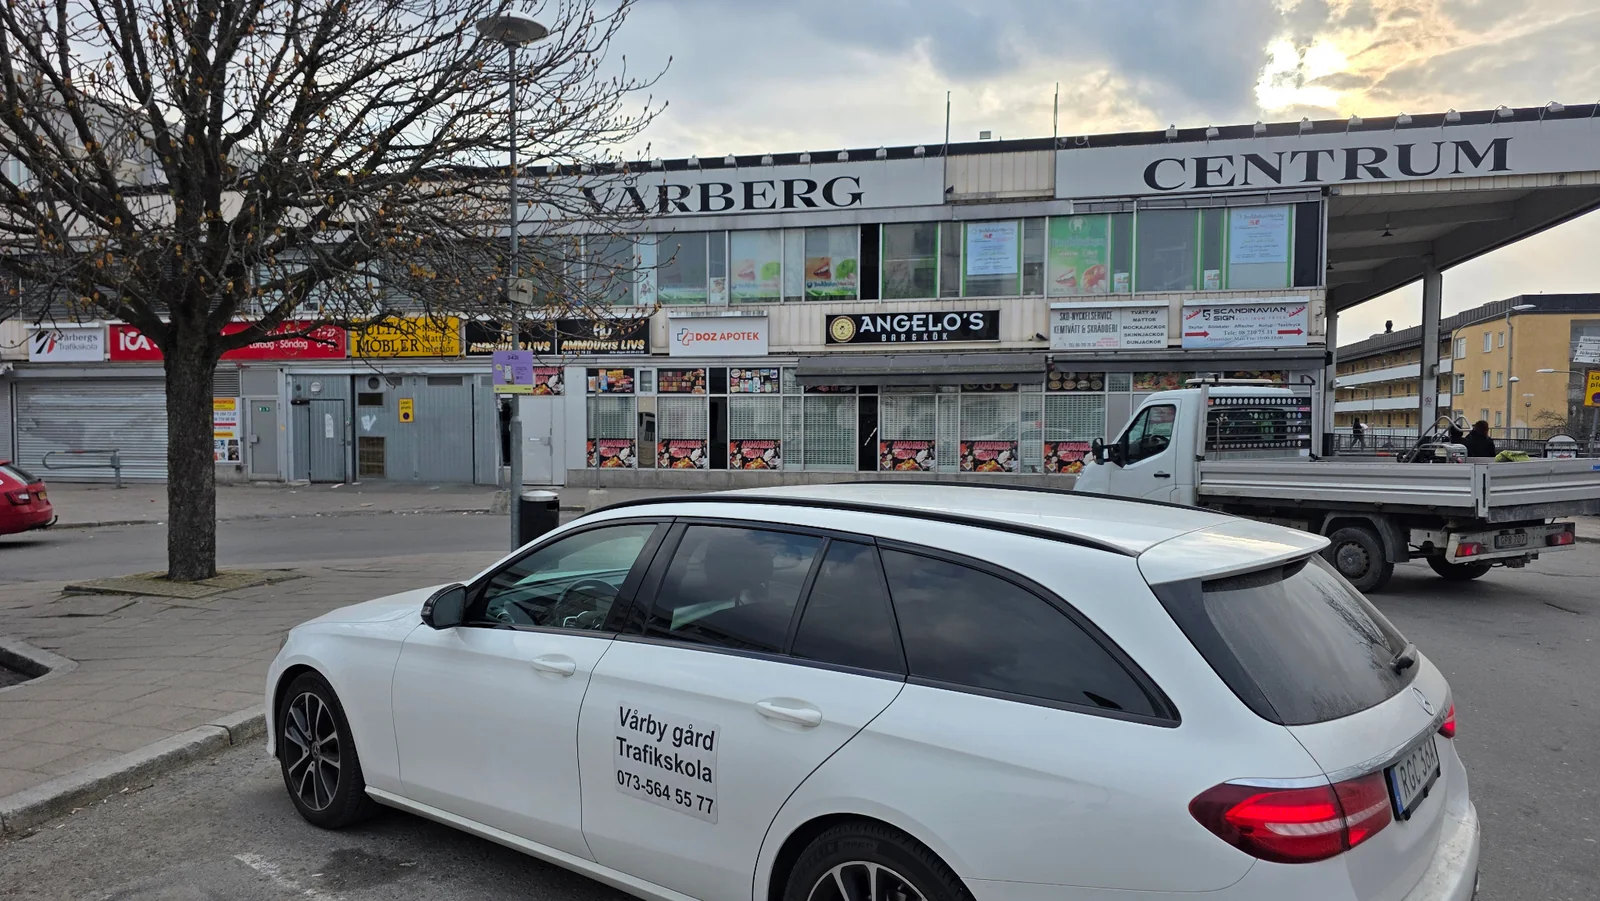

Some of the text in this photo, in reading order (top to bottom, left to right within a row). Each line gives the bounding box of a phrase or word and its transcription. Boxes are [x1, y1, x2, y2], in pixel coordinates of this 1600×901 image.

[583, 137, 1513, 214] VÅRBERG CENTRUM
[1213, 306, 1287, 314] SCANDINAVIAN
[859, 312, 984, 333] ANGELO'S
[1053, 323, 1081, 334] KEMTVÄTT
[1081, 324, 1086, 334] &
[119, 331, 151, 351] ICA
[279, 339, 309, 350] Söndag
[355, 336, 420, 353] MÖBLER
[561, 339, 646, 351] AMMOURIS LIVS
[695, 331, 760, 341] DOZ APOTEK
[619, 705, 716, 752] Vårby gård
[616, 735, 713, 784] Trafikskola
[1400, 753, 1421, 799] RGC
[617, 769, 714, 815] 073-564 55 77
